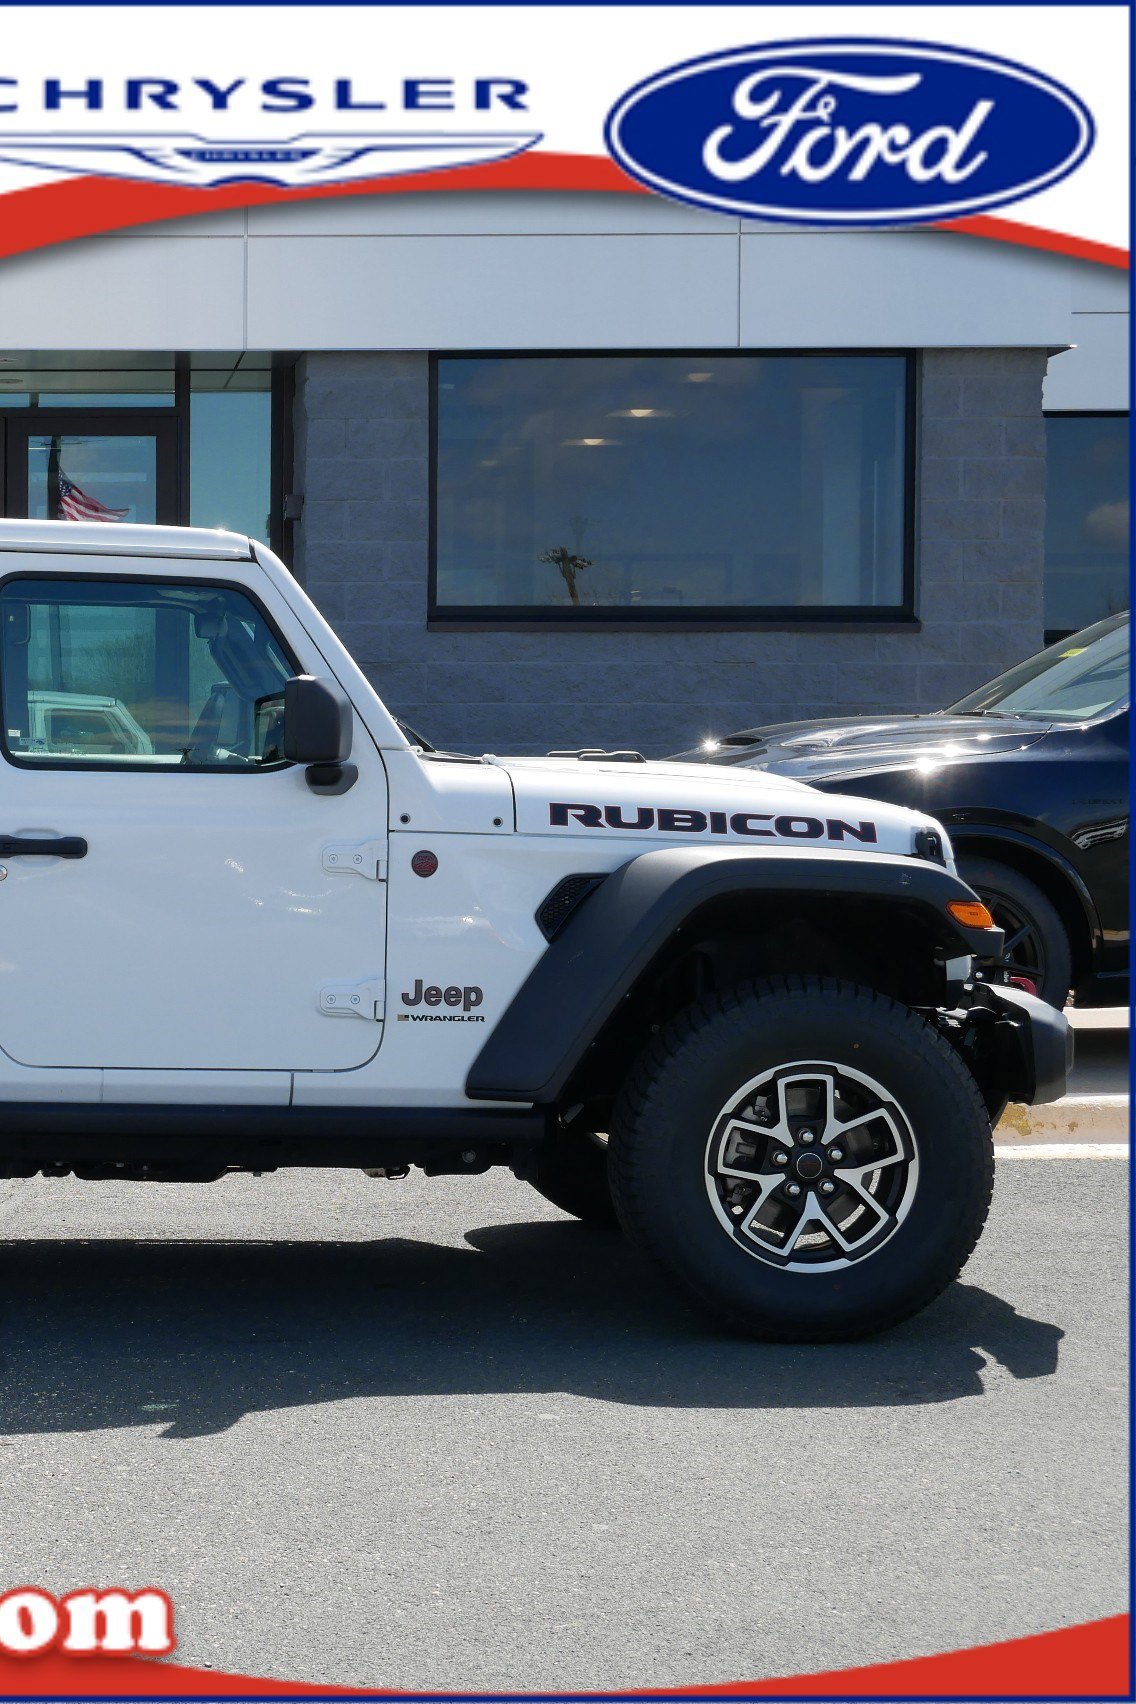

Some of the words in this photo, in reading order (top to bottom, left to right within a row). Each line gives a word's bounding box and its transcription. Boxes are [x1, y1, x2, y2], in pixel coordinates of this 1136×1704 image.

[548, 801, 879, 844] RUBICON
[401, 979, 484, 1012] Jeep
[410, 1014, 486, 1023] WRANGLER
